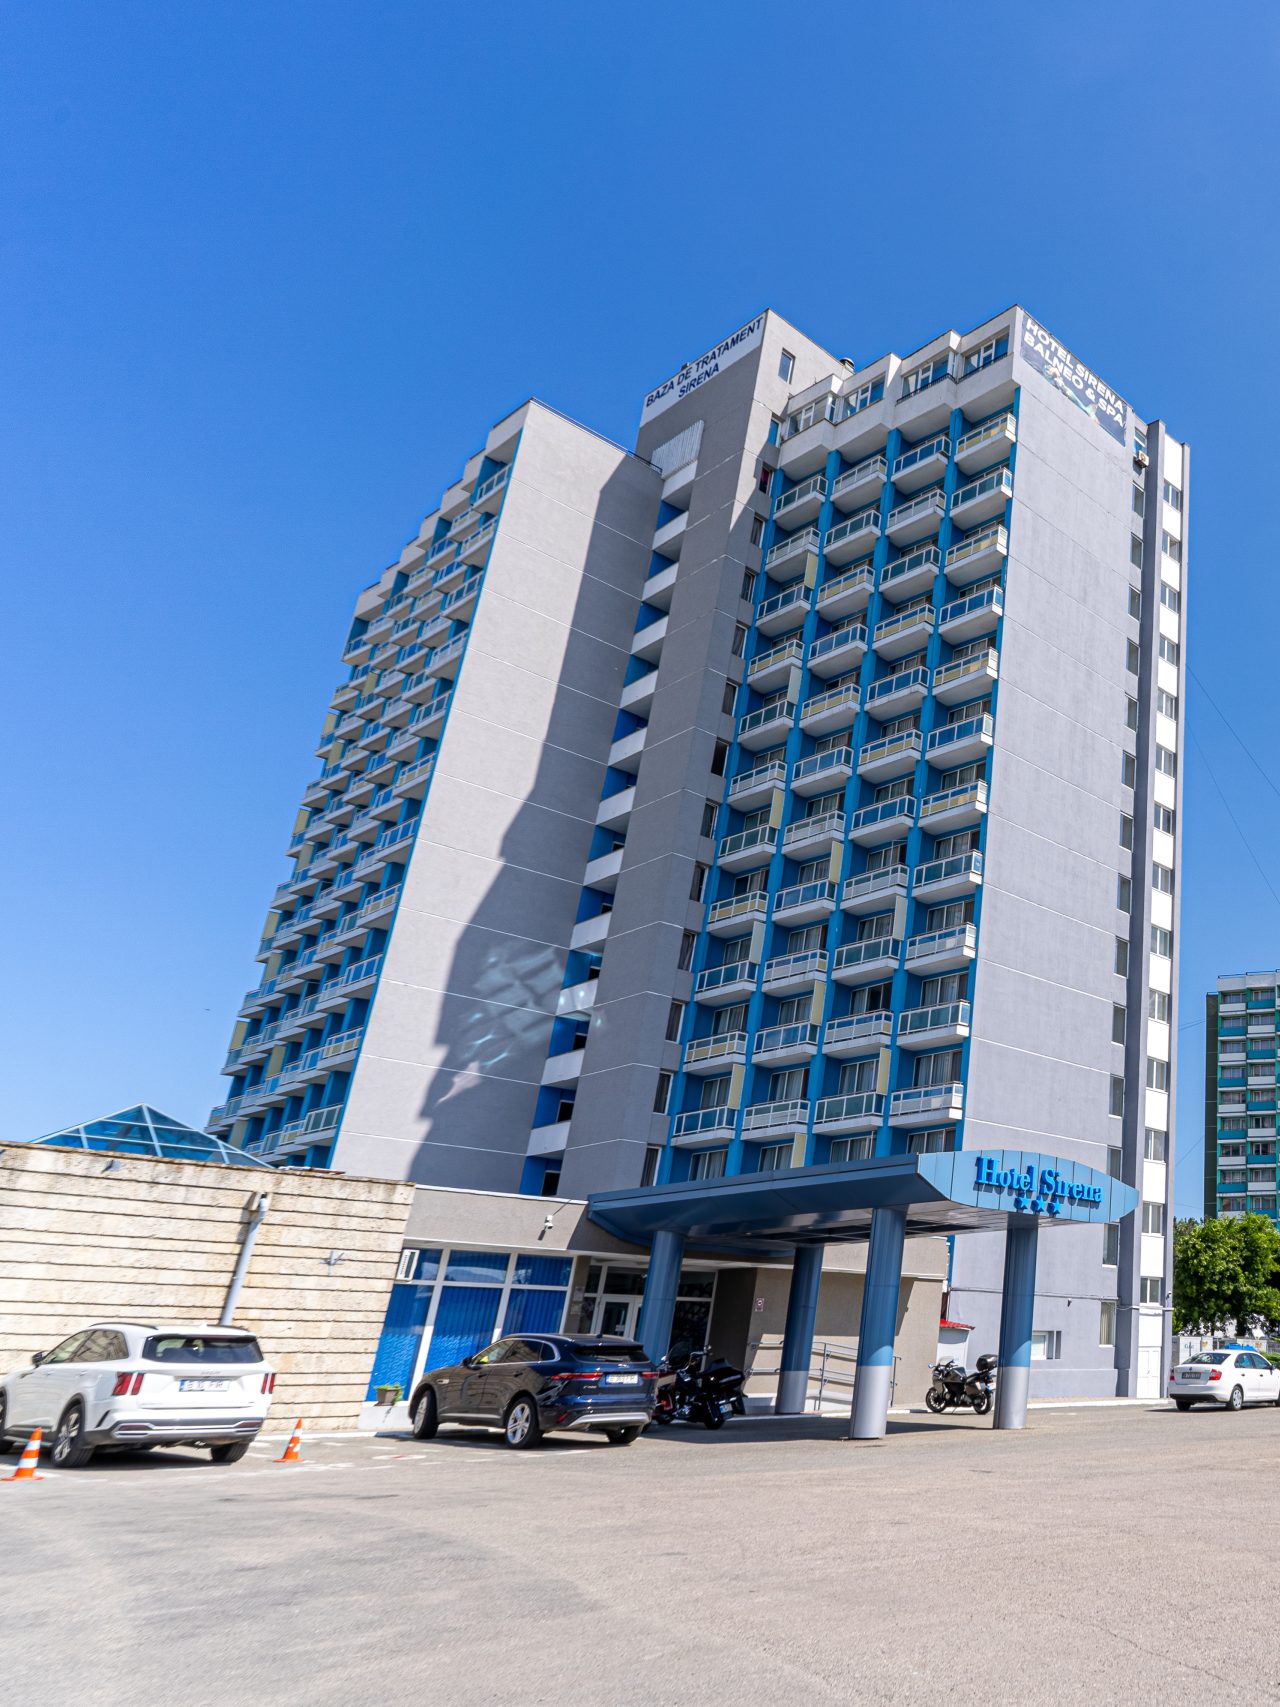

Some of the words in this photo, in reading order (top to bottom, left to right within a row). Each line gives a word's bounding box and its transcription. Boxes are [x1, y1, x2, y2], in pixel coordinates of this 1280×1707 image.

[646, 380, 675, 407] BAZA
[677, 367, 692, 386] DE
[695, 316, 764, 372] TRATAMENT
[678, 362, 720, 398] SIRENA
[1024, 331, 1084, 389] BALNEO
[1085, 387, 1096, 403] &
[1097, 398, 1124, 427] SPA
[1026, 318, 1074, 369] HOTEL
[1075, 364, 1124, 414] SIRENA
[975, 1156, 1038, 1192] Hotel
[1039, 1168, 1105, 1203] Sirena
